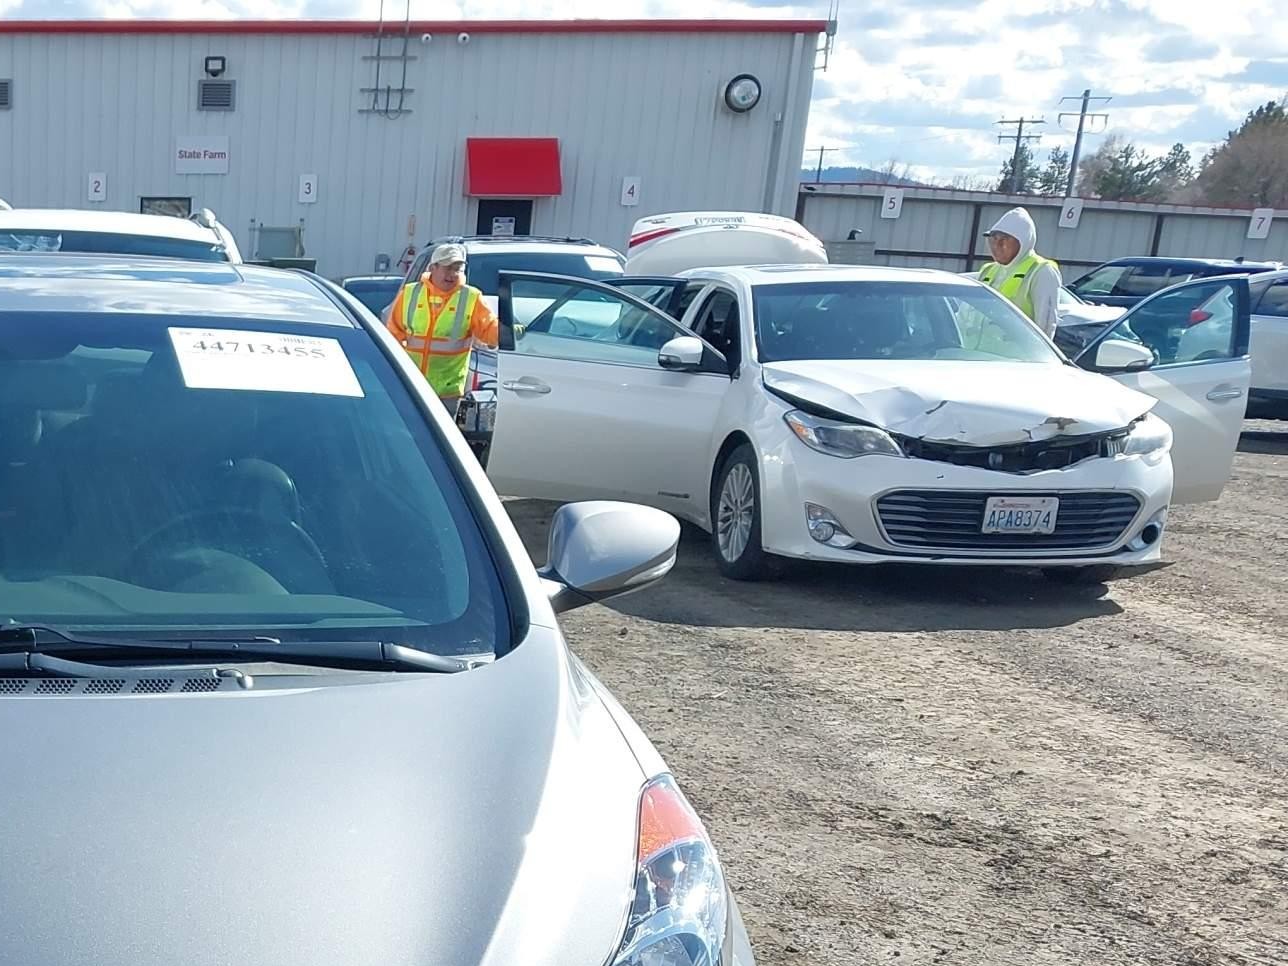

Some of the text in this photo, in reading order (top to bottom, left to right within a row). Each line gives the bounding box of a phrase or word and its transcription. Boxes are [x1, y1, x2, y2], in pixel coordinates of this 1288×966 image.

[178, 149, 226, 159] State Farm
[94, 180, 101, 193] 2
[304, 182, 312, 195] 3
[627, 183, 635, 197] 4
[887, 196, 896, 210] 5
[1066, 206, 1074, 219] 6
[1257, 216, 1266, 230] 7
[192, 340, 326, 359] 44713455
[987, 510, 1051, 528] APA8374
